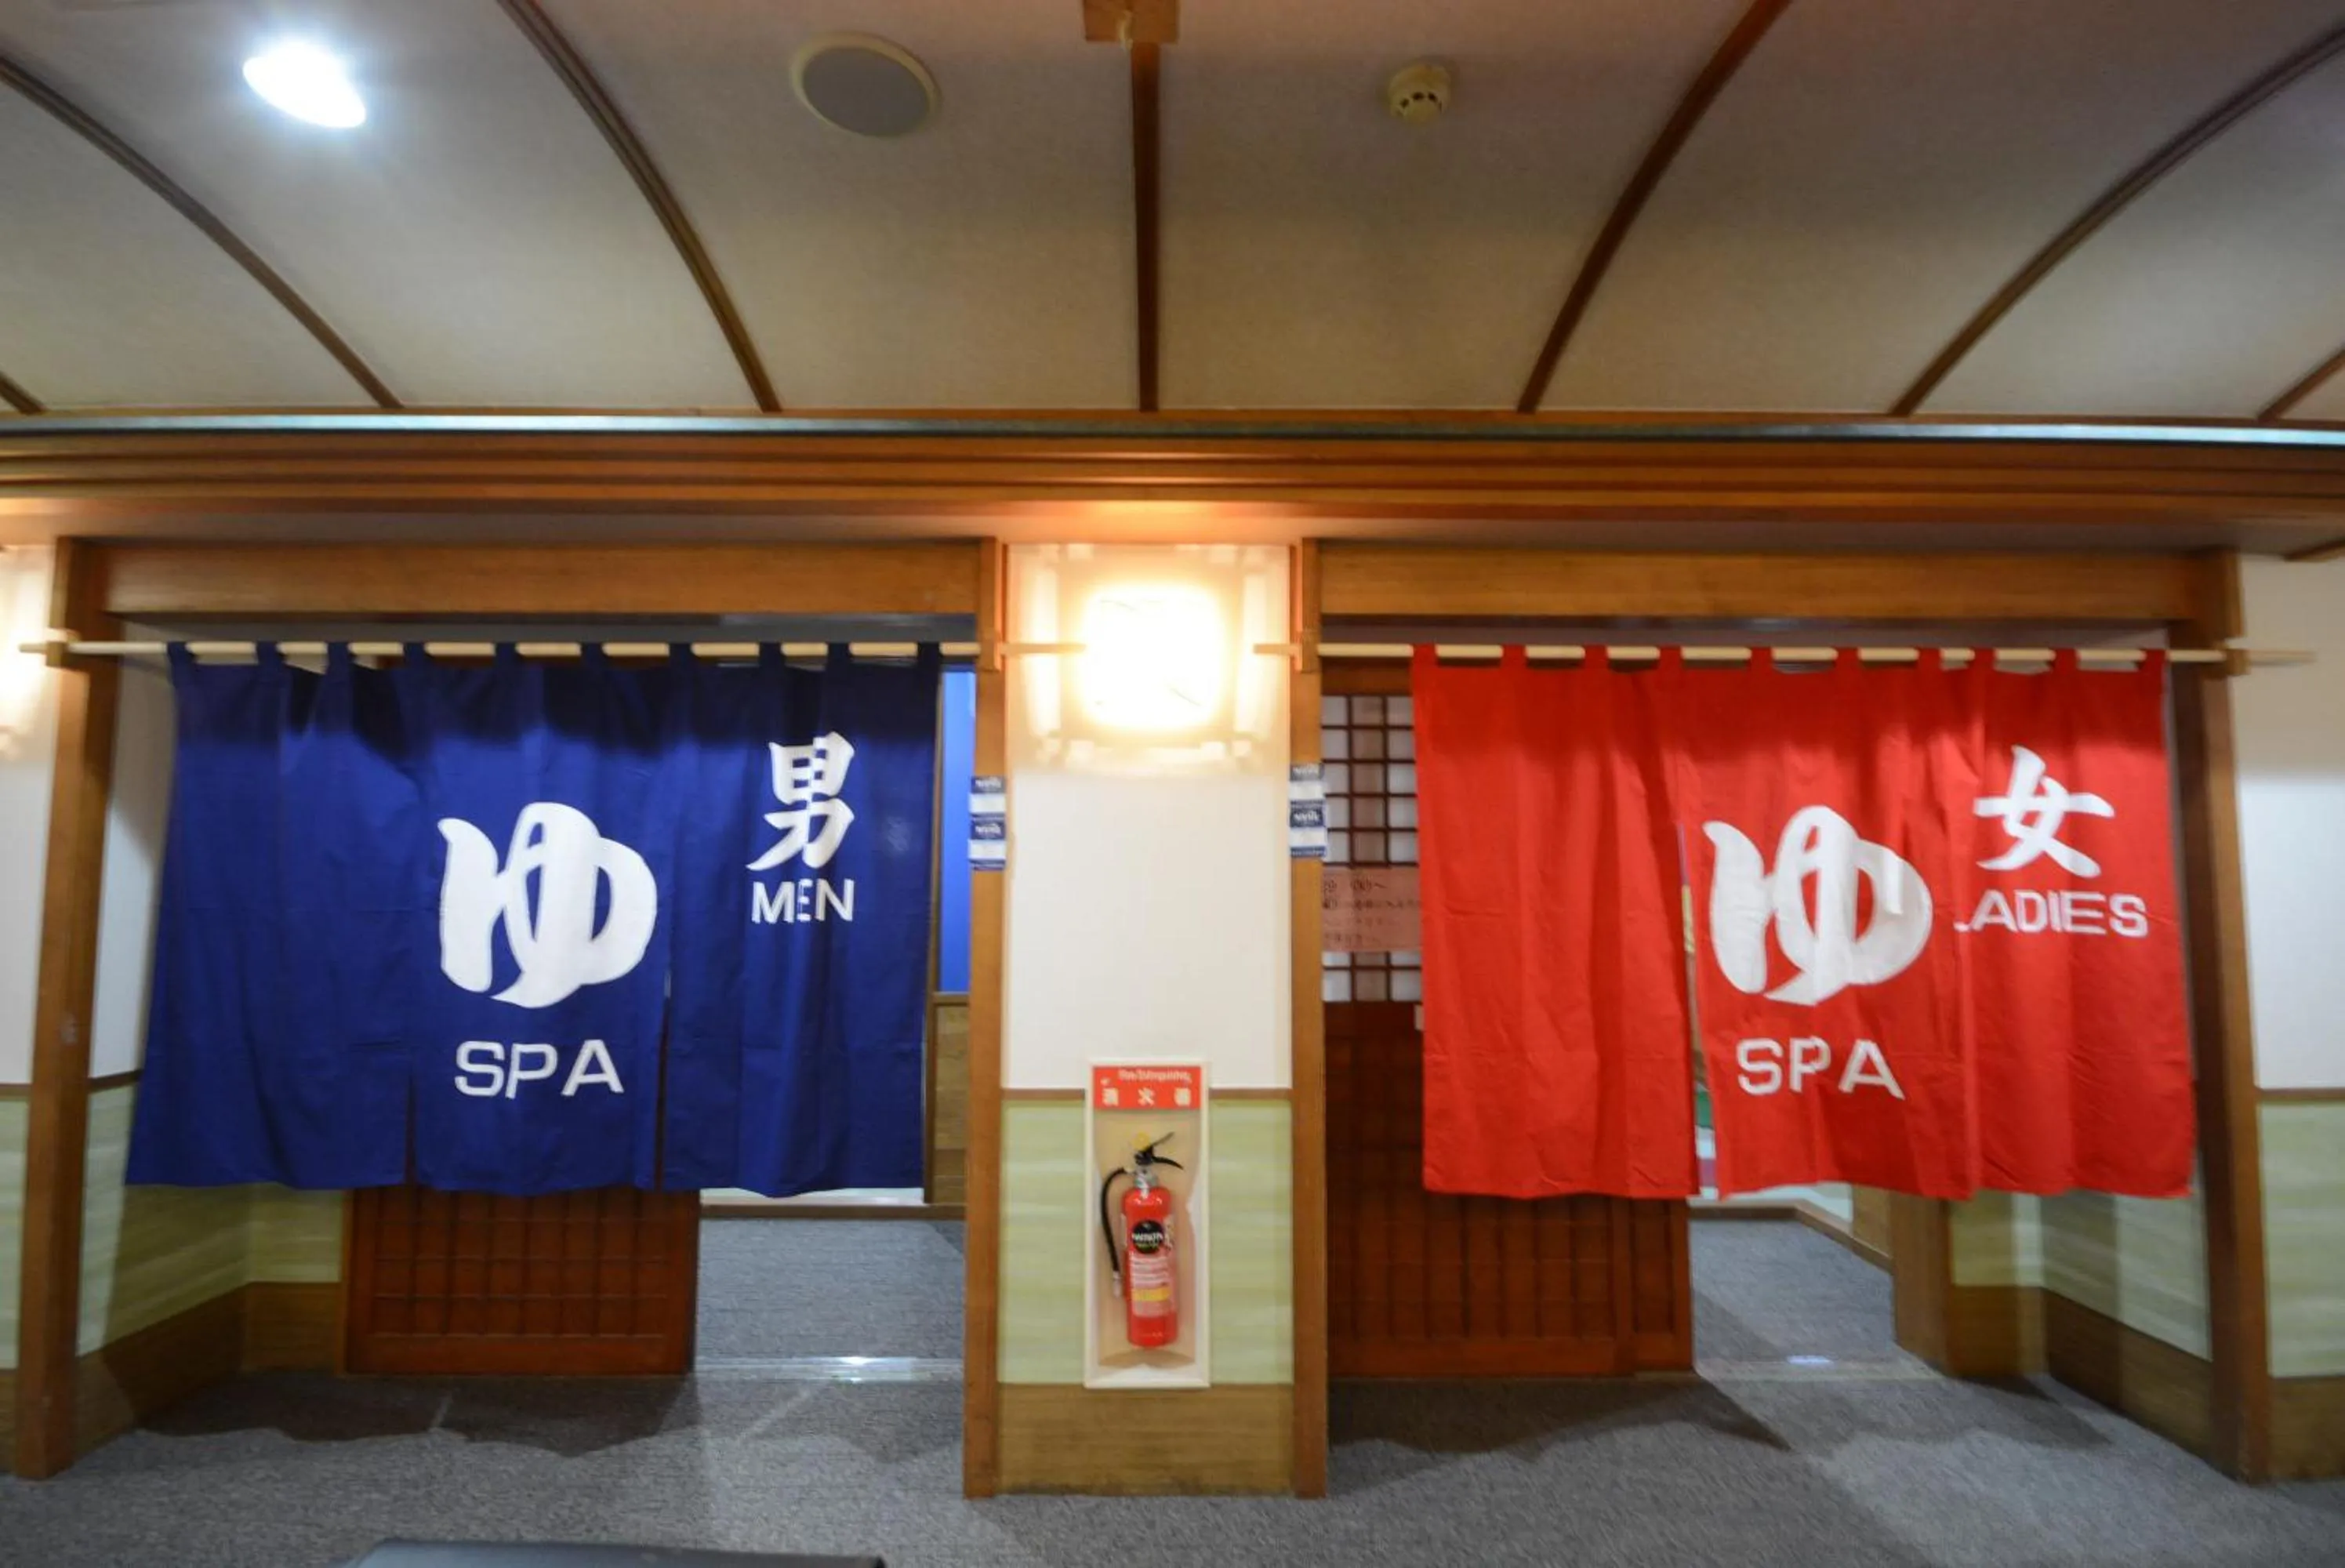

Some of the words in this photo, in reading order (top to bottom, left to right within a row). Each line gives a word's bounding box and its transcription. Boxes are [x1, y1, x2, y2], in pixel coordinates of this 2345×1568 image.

[746, 731, 855, 871] 男
[1973, 746, 2115, 878] 女
[437, 801, 658, 1008] ゆ
[751, 878, 855, 924] MEN
[1702, 804, 1933, 1006] ゆ
[1954, 889, 2149, 938] ADIES
[455, 1039, 624, 1099] SPA
[1737, 1036, 1906, 1100] SPA
